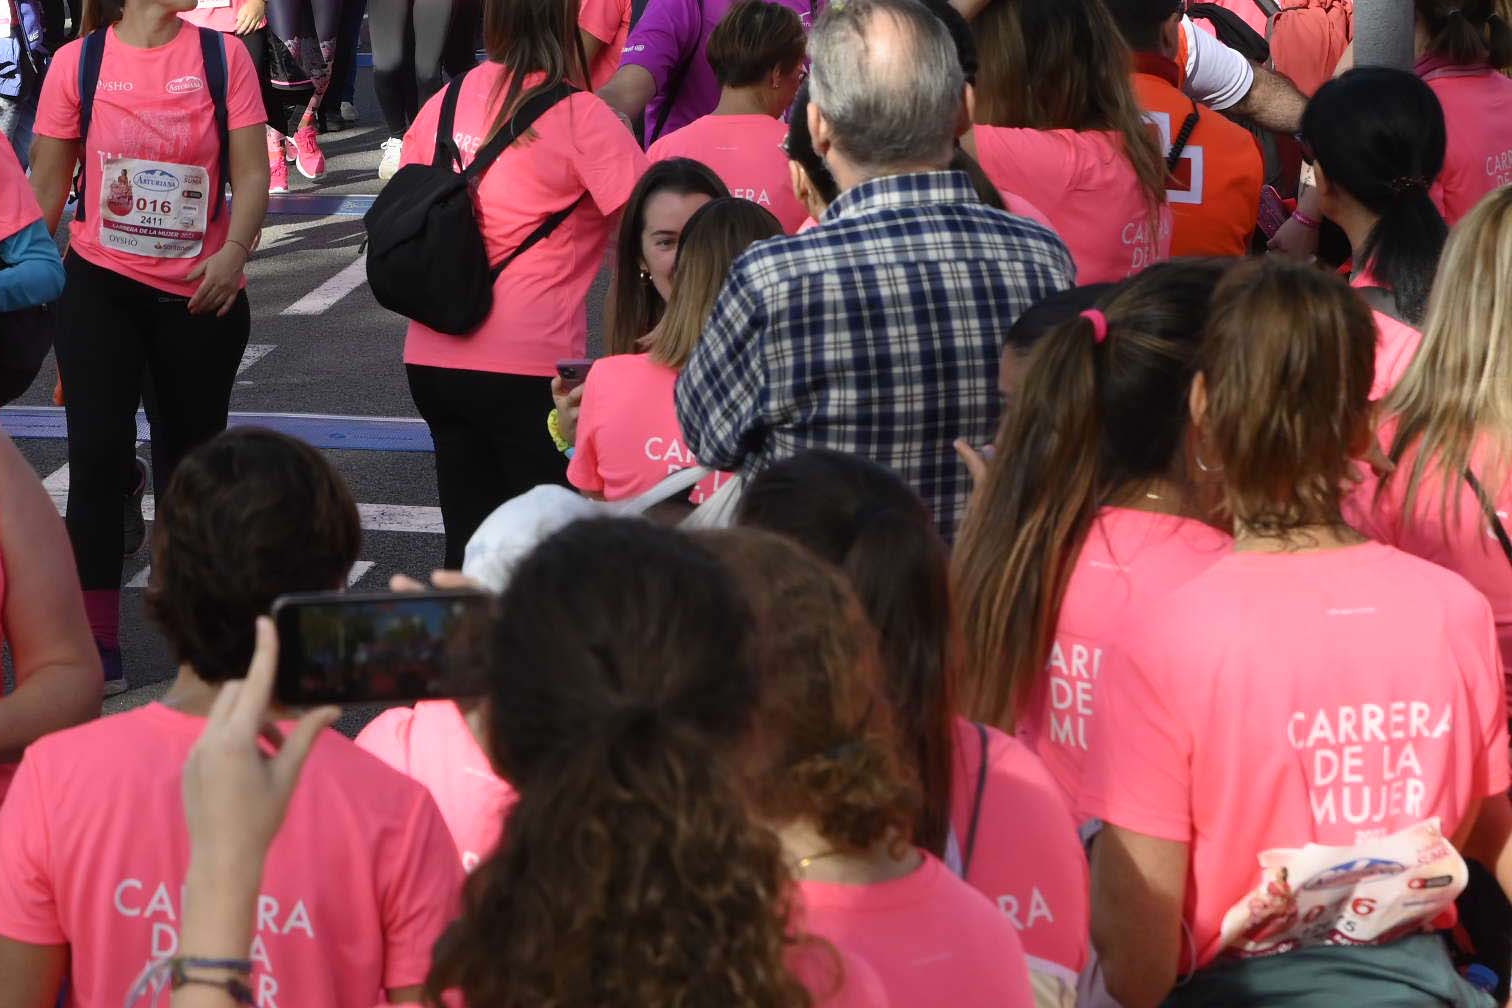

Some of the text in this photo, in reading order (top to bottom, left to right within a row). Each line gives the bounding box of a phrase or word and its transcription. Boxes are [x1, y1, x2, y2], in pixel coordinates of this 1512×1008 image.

[137, 174, 176, 188] ASTURIANA
[136, 197, 172, 214] 016
[140, 215, 163, 226] 2411
[158, 229, 179, 238] MUJER
[109, 234, 138, 248] OYSHO
[1051, 677, 1094, 716] DE
[1289, 701, 1453, 751] CARRERA
[1314, 742, 1423, 787] DE LA
[1310, 779, 1426, 826] MUJER
[114, 877, 315, 939] CARA
